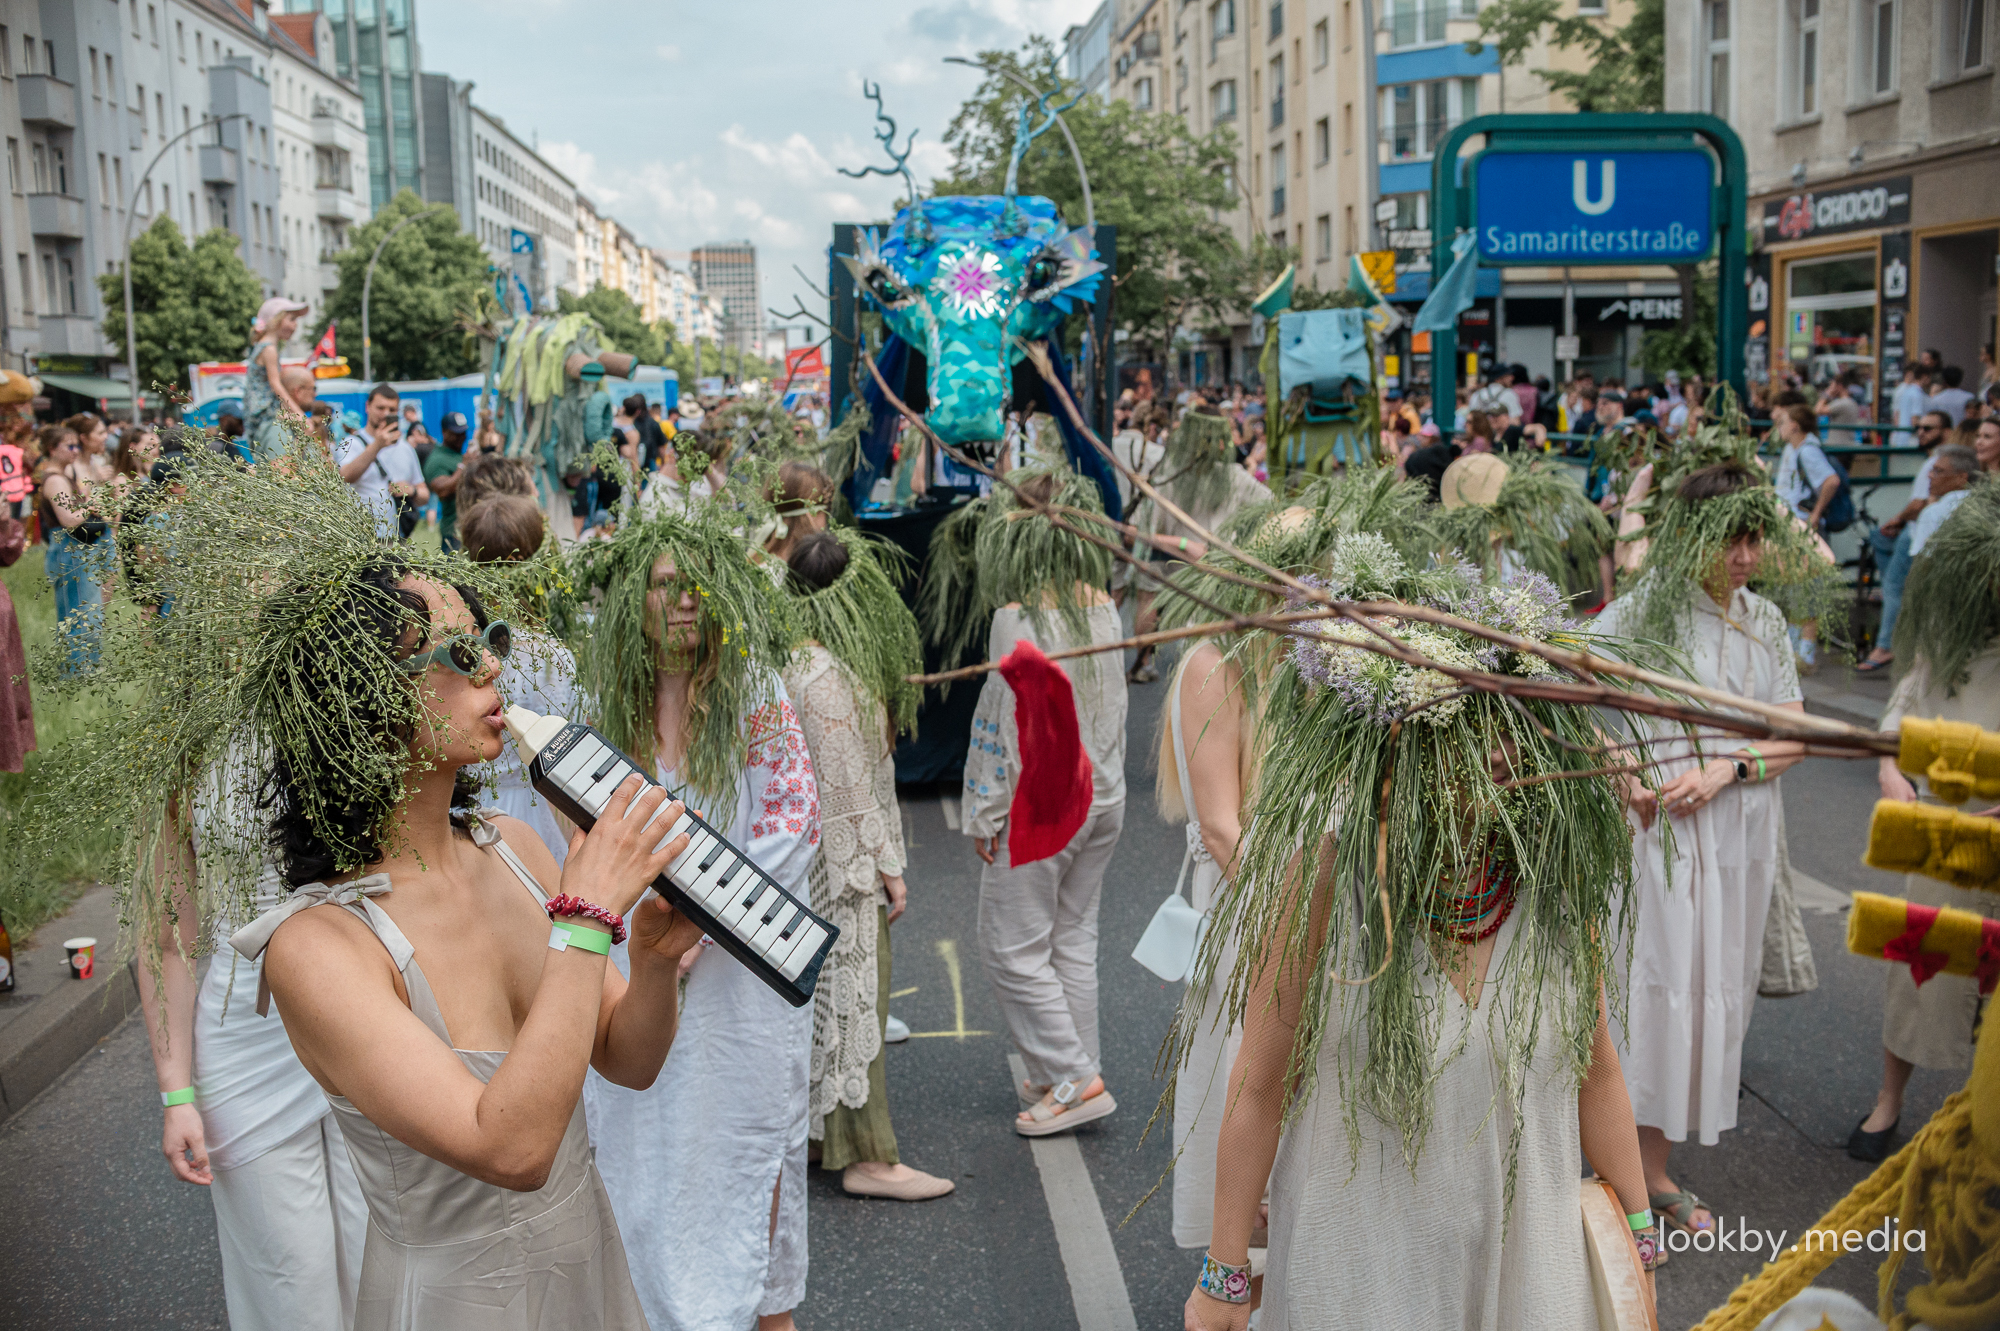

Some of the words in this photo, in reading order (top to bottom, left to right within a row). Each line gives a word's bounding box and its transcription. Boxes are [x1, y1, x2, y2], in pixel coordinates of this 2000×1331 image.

[1573, 159, 1616, 216] U
[1817, 187, 1889, 228] CHOCO
[1486, 221, 1700, 254] Samariterstraße
[550, 728, 571, 750] HOHNER
